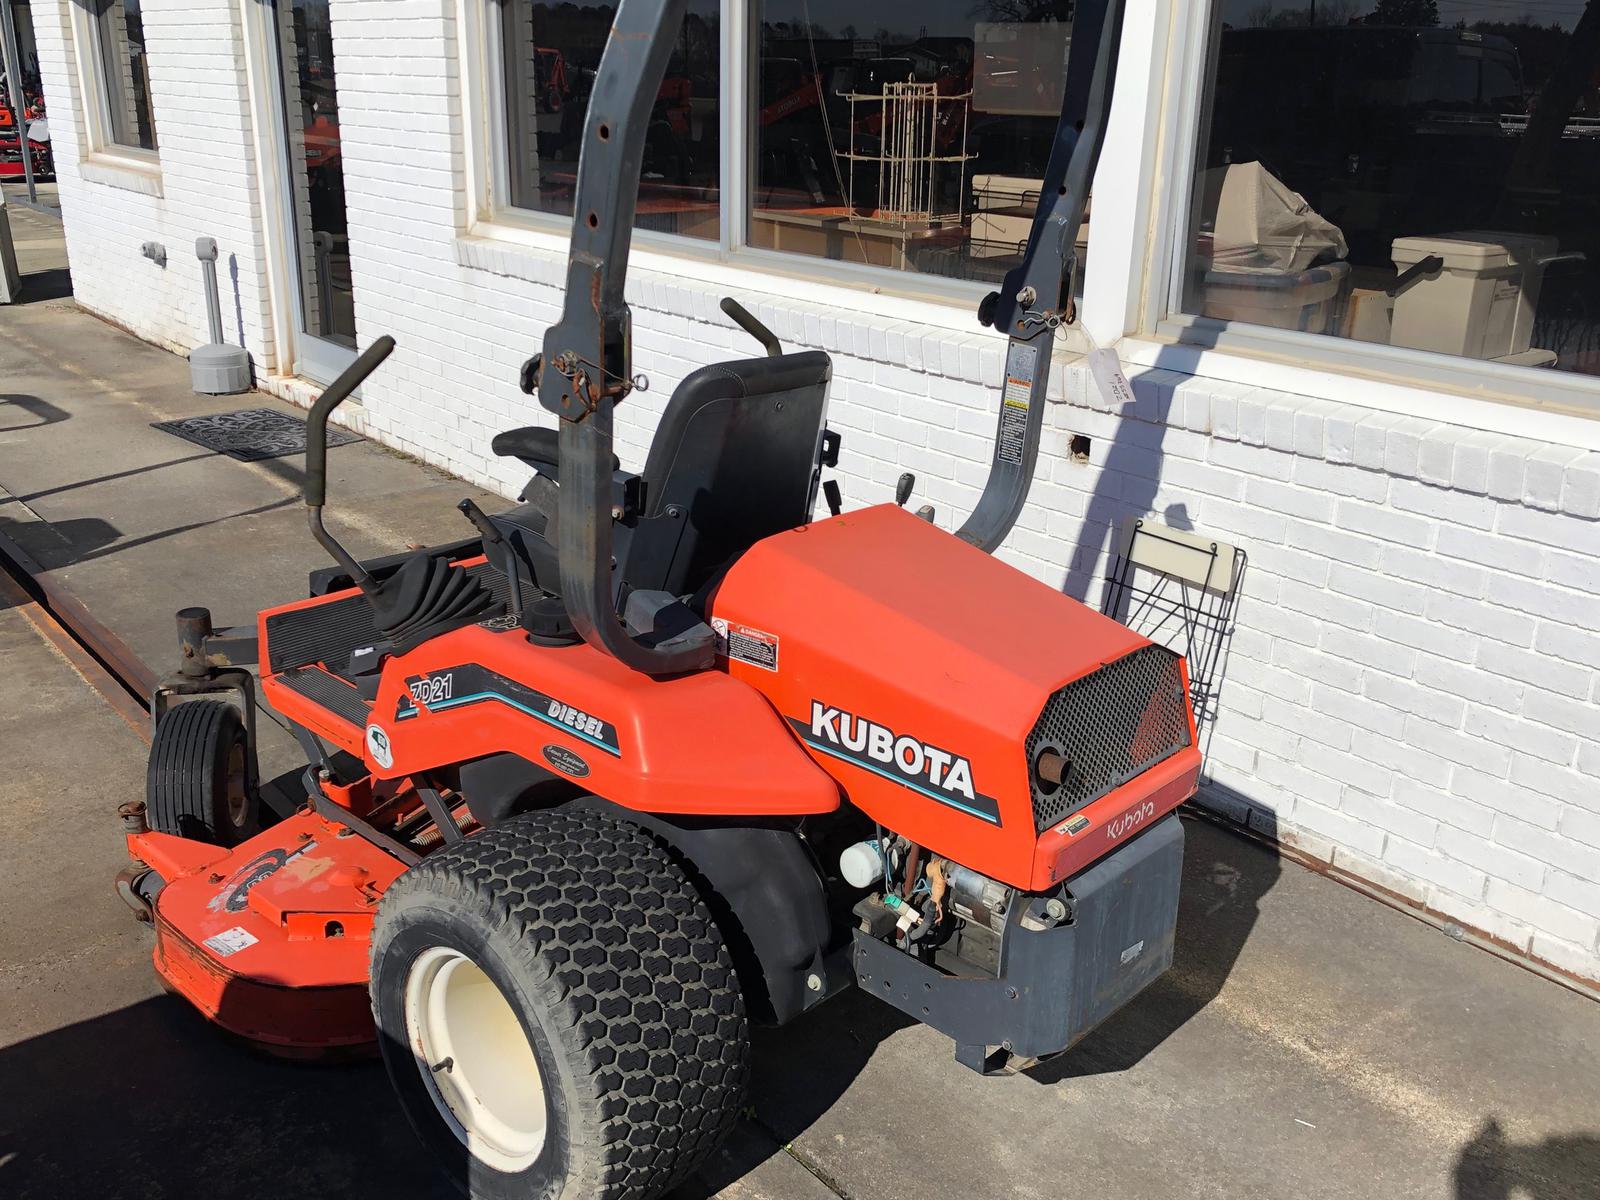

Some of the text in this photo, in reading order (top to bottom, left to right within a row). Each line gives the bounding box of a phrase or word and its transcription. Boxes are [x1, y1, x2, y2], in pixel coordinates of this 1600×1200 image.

[410, 673, 453, 708] ZD21
[548, 700, 604, 739] DIESEL
[812, 701, 975, 800] KUBOTA
[1106, 801, 1154, 840] Kubota
